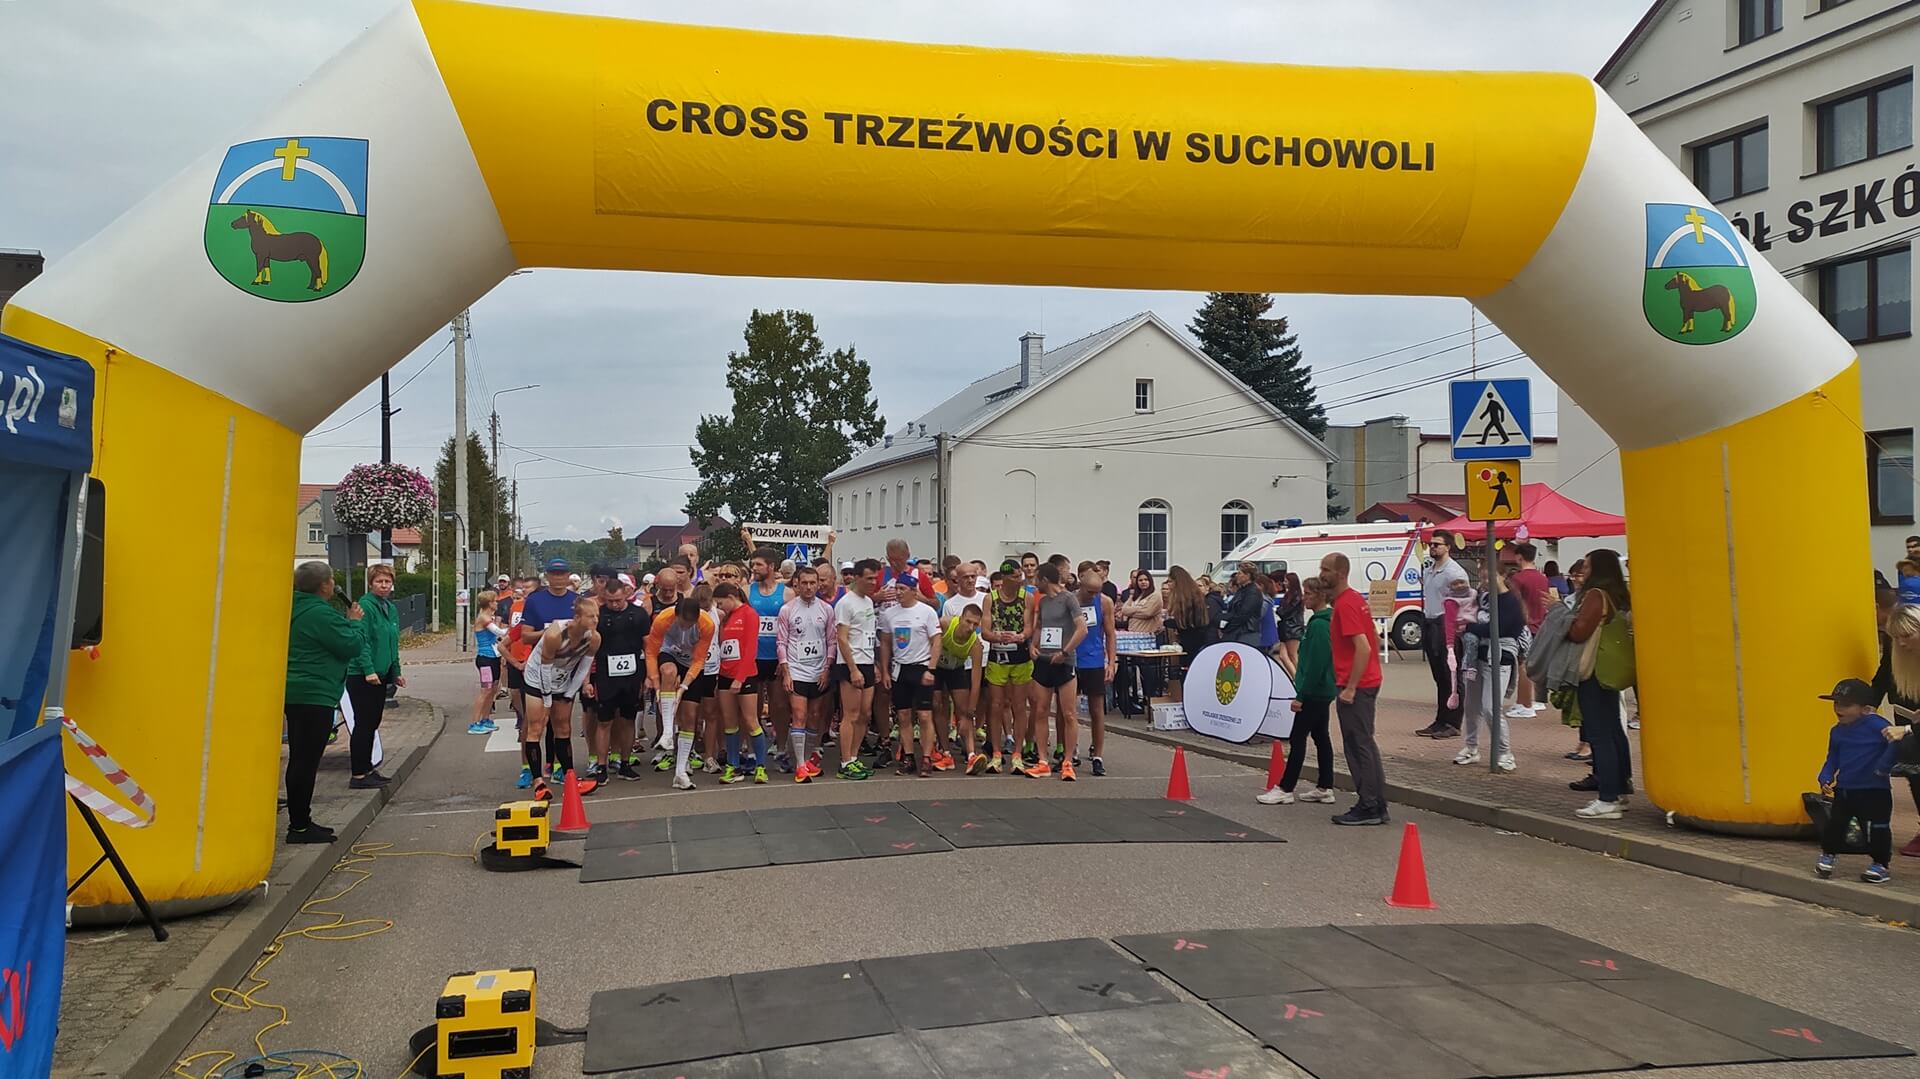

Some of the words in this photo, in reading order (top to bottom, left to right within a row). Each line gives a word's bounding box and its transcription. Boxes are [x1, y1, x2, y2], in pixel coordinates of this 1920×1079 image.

[646, 98, 809, 141] CROSS
[824, 111, 1118, 160] TRZEŹWOŚCI
[1133, 129, 1171, 161] W
[1185, 132, 1435, 171] SUCHOWOLI
[750, 527, 819, 539] POZDRAWIAM
[760, 621, 774, 632] 78
[1046, 633, 1052, 642] 2
[723, 644, 733, 655] 49
[804, 646, 818, 657] 94
[616, 660, 630, 671] 62
